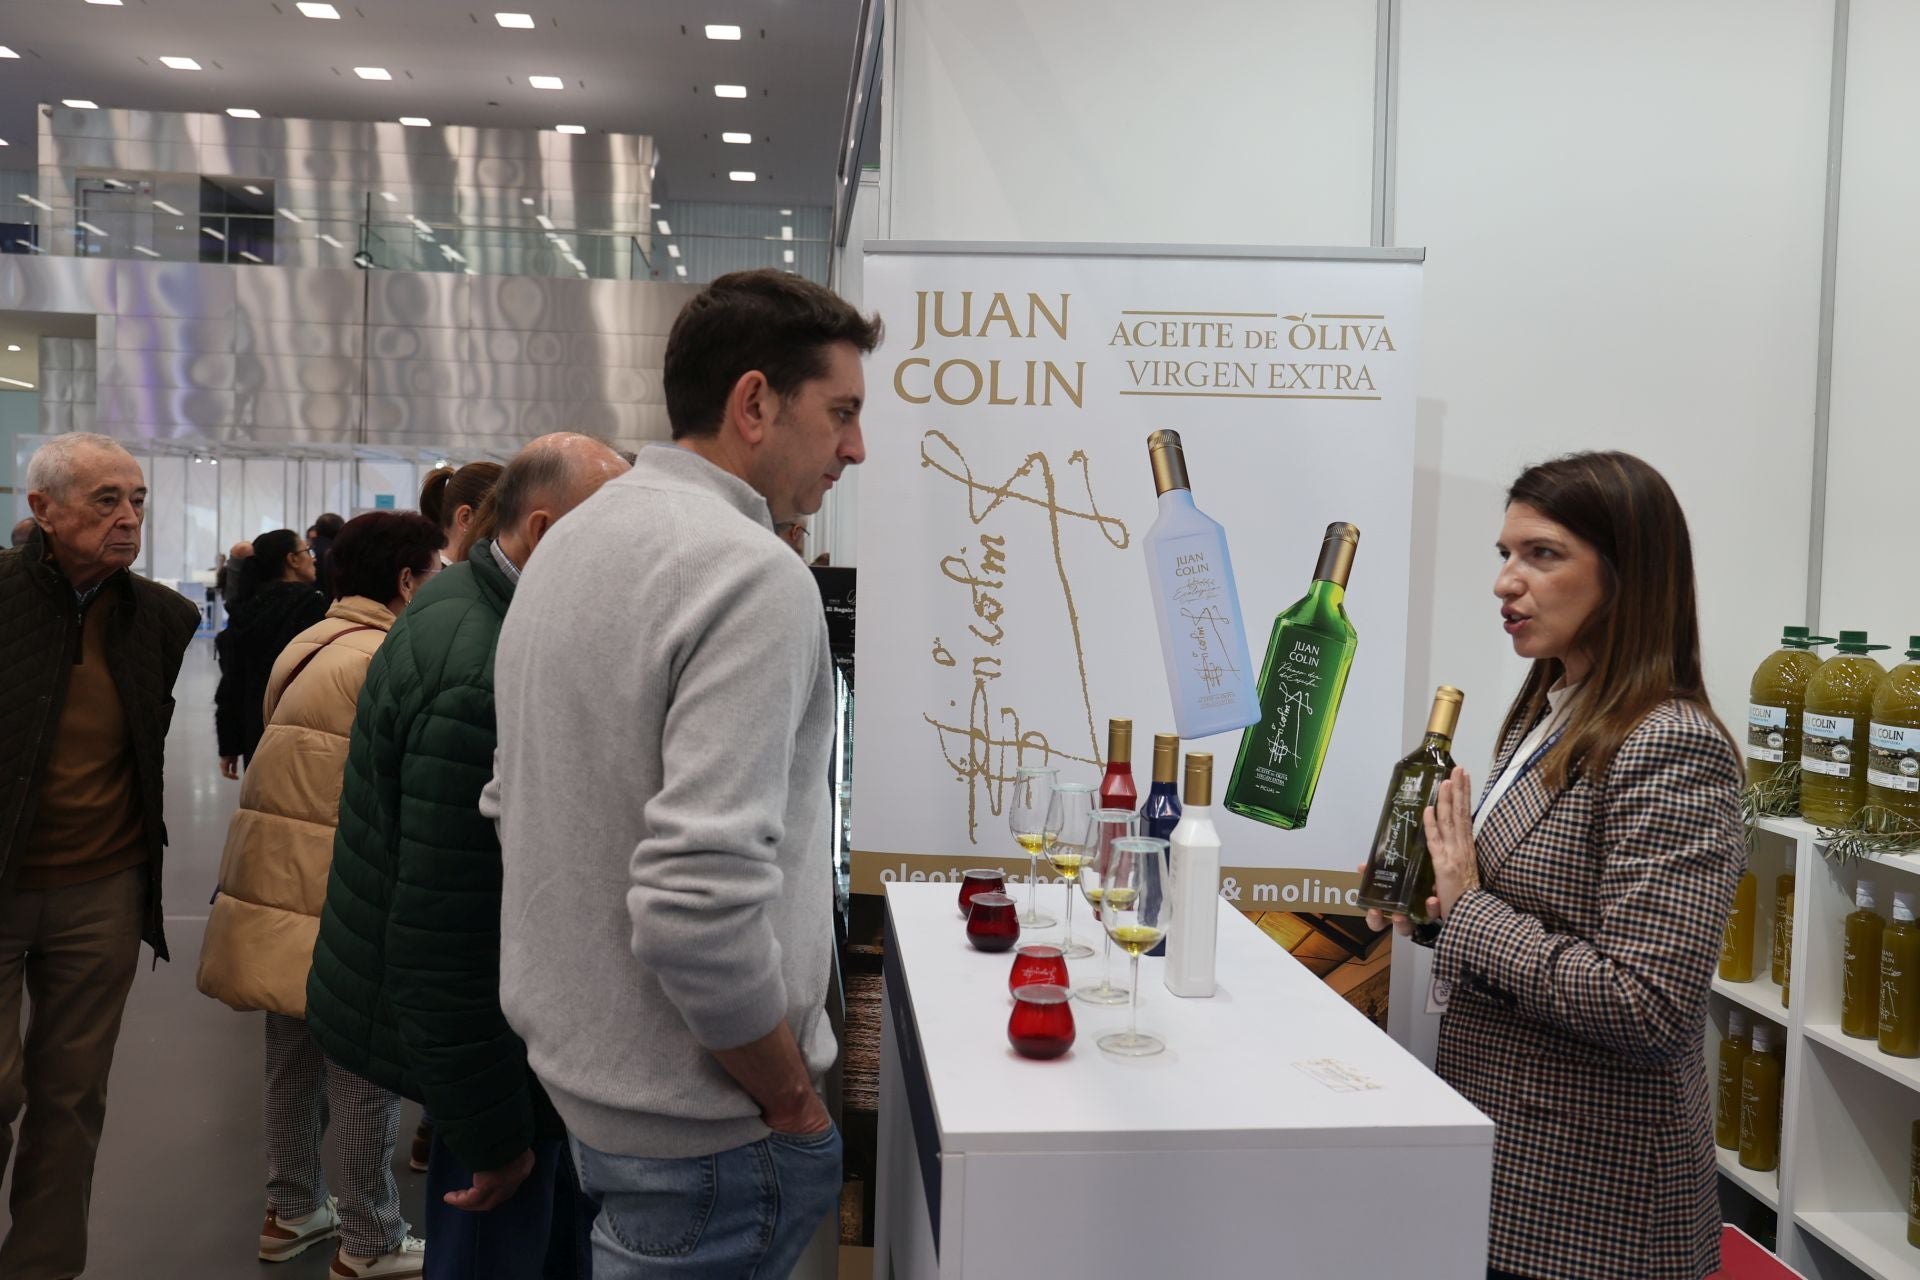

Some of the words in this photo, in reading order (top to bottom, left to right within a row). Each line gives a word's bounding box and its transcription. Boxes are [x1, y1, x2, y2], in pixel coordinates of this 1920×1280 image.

[909, 291, 1072, 351] JUAN
[1107, 320, 1234, 349] ACEITE
[1243, 330, 1278, 350] DE
[1287, 321, 1397, 353] OLIVA
[893, 357, 1087, 409] COLIN
[1125, 359, 1258, 391] VIRGEN
[1267, 362, 1377, 391] EXTRA
[1176, 552, 1204, 568] JUAN
[1175, 563, 1209, 577] COLIN
[1293, 641, 1320, 655] JUAN
[1289, 651, 1320, 667] COLIN
[1811, 717, 1837, 730] COLIN
[1878, 728, 1905, 742] COLIN
